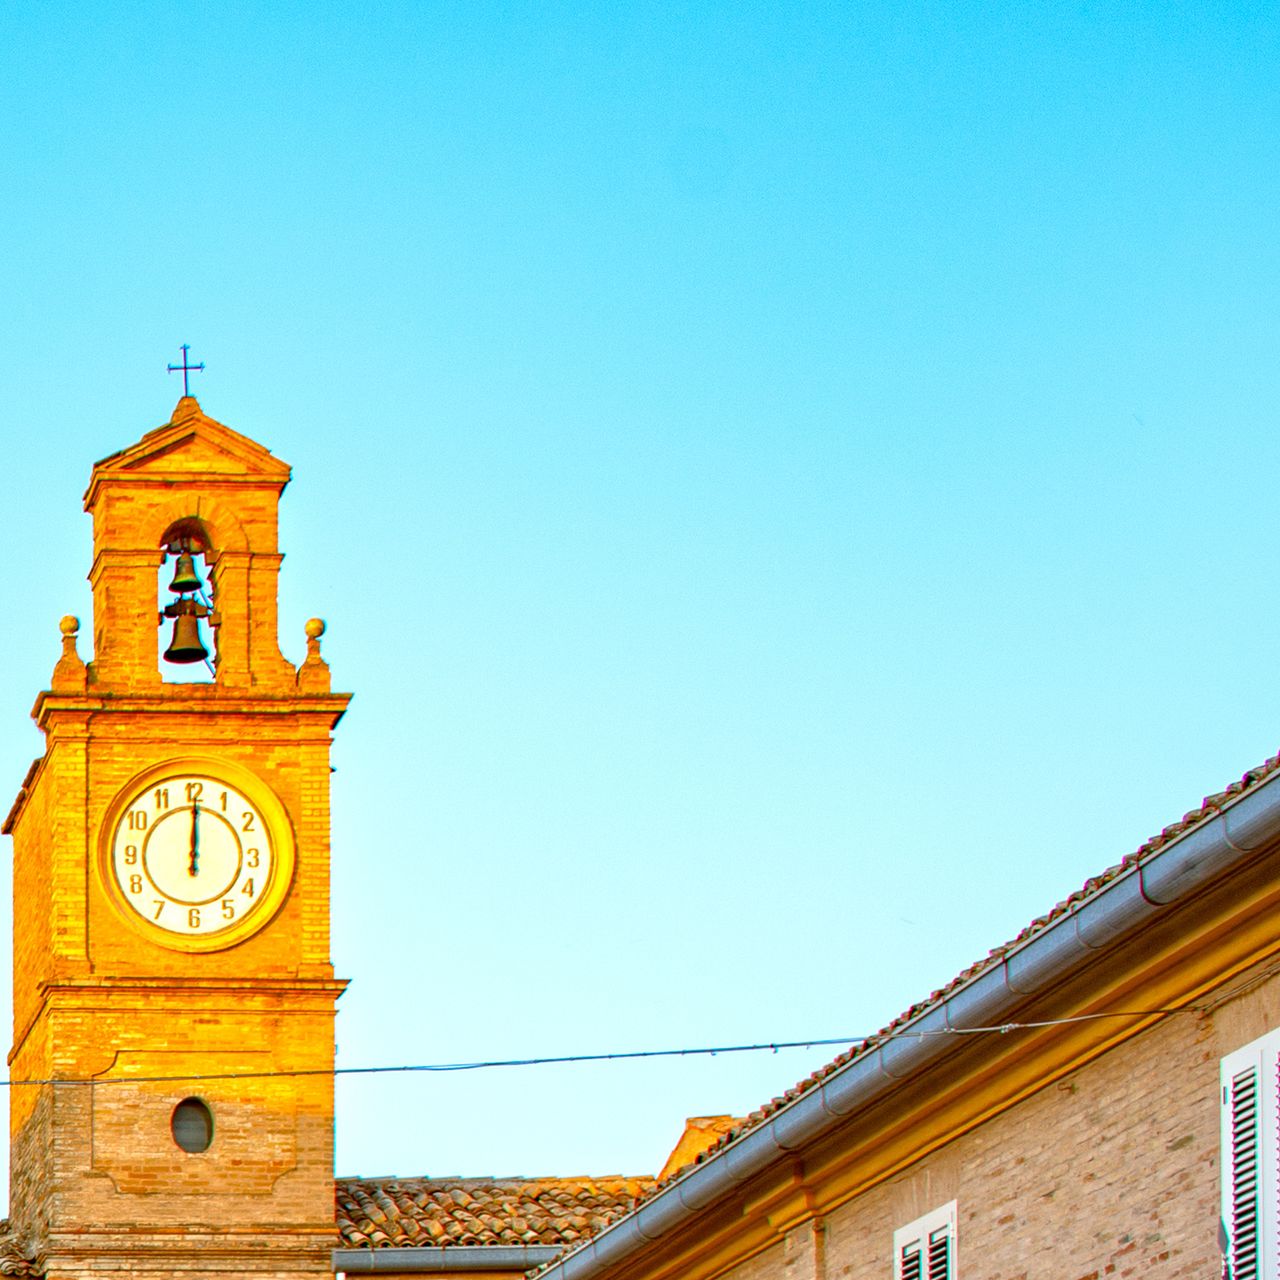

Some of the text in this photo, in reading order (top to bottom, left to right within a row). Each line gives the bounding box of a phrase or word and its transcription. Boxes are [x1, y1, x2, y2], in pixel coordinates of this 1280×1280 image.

[155, 789, 169, 808] 11
[185, 782, 203, 802] 12
[221, 792, 227, 811] 1
[128, 811, 146, 830] 10
[242, 812, 254, 831] 2
[125, 846, 136, 864] 9
[247, 848, 259, 868] 3
[130, 875, 142, 893] 8
[242, 878, 254, 897] 4
[153, 901, 165, 919] 7
[189, 908, 200, 928] 6
[222, 900, 234, 919] 5
